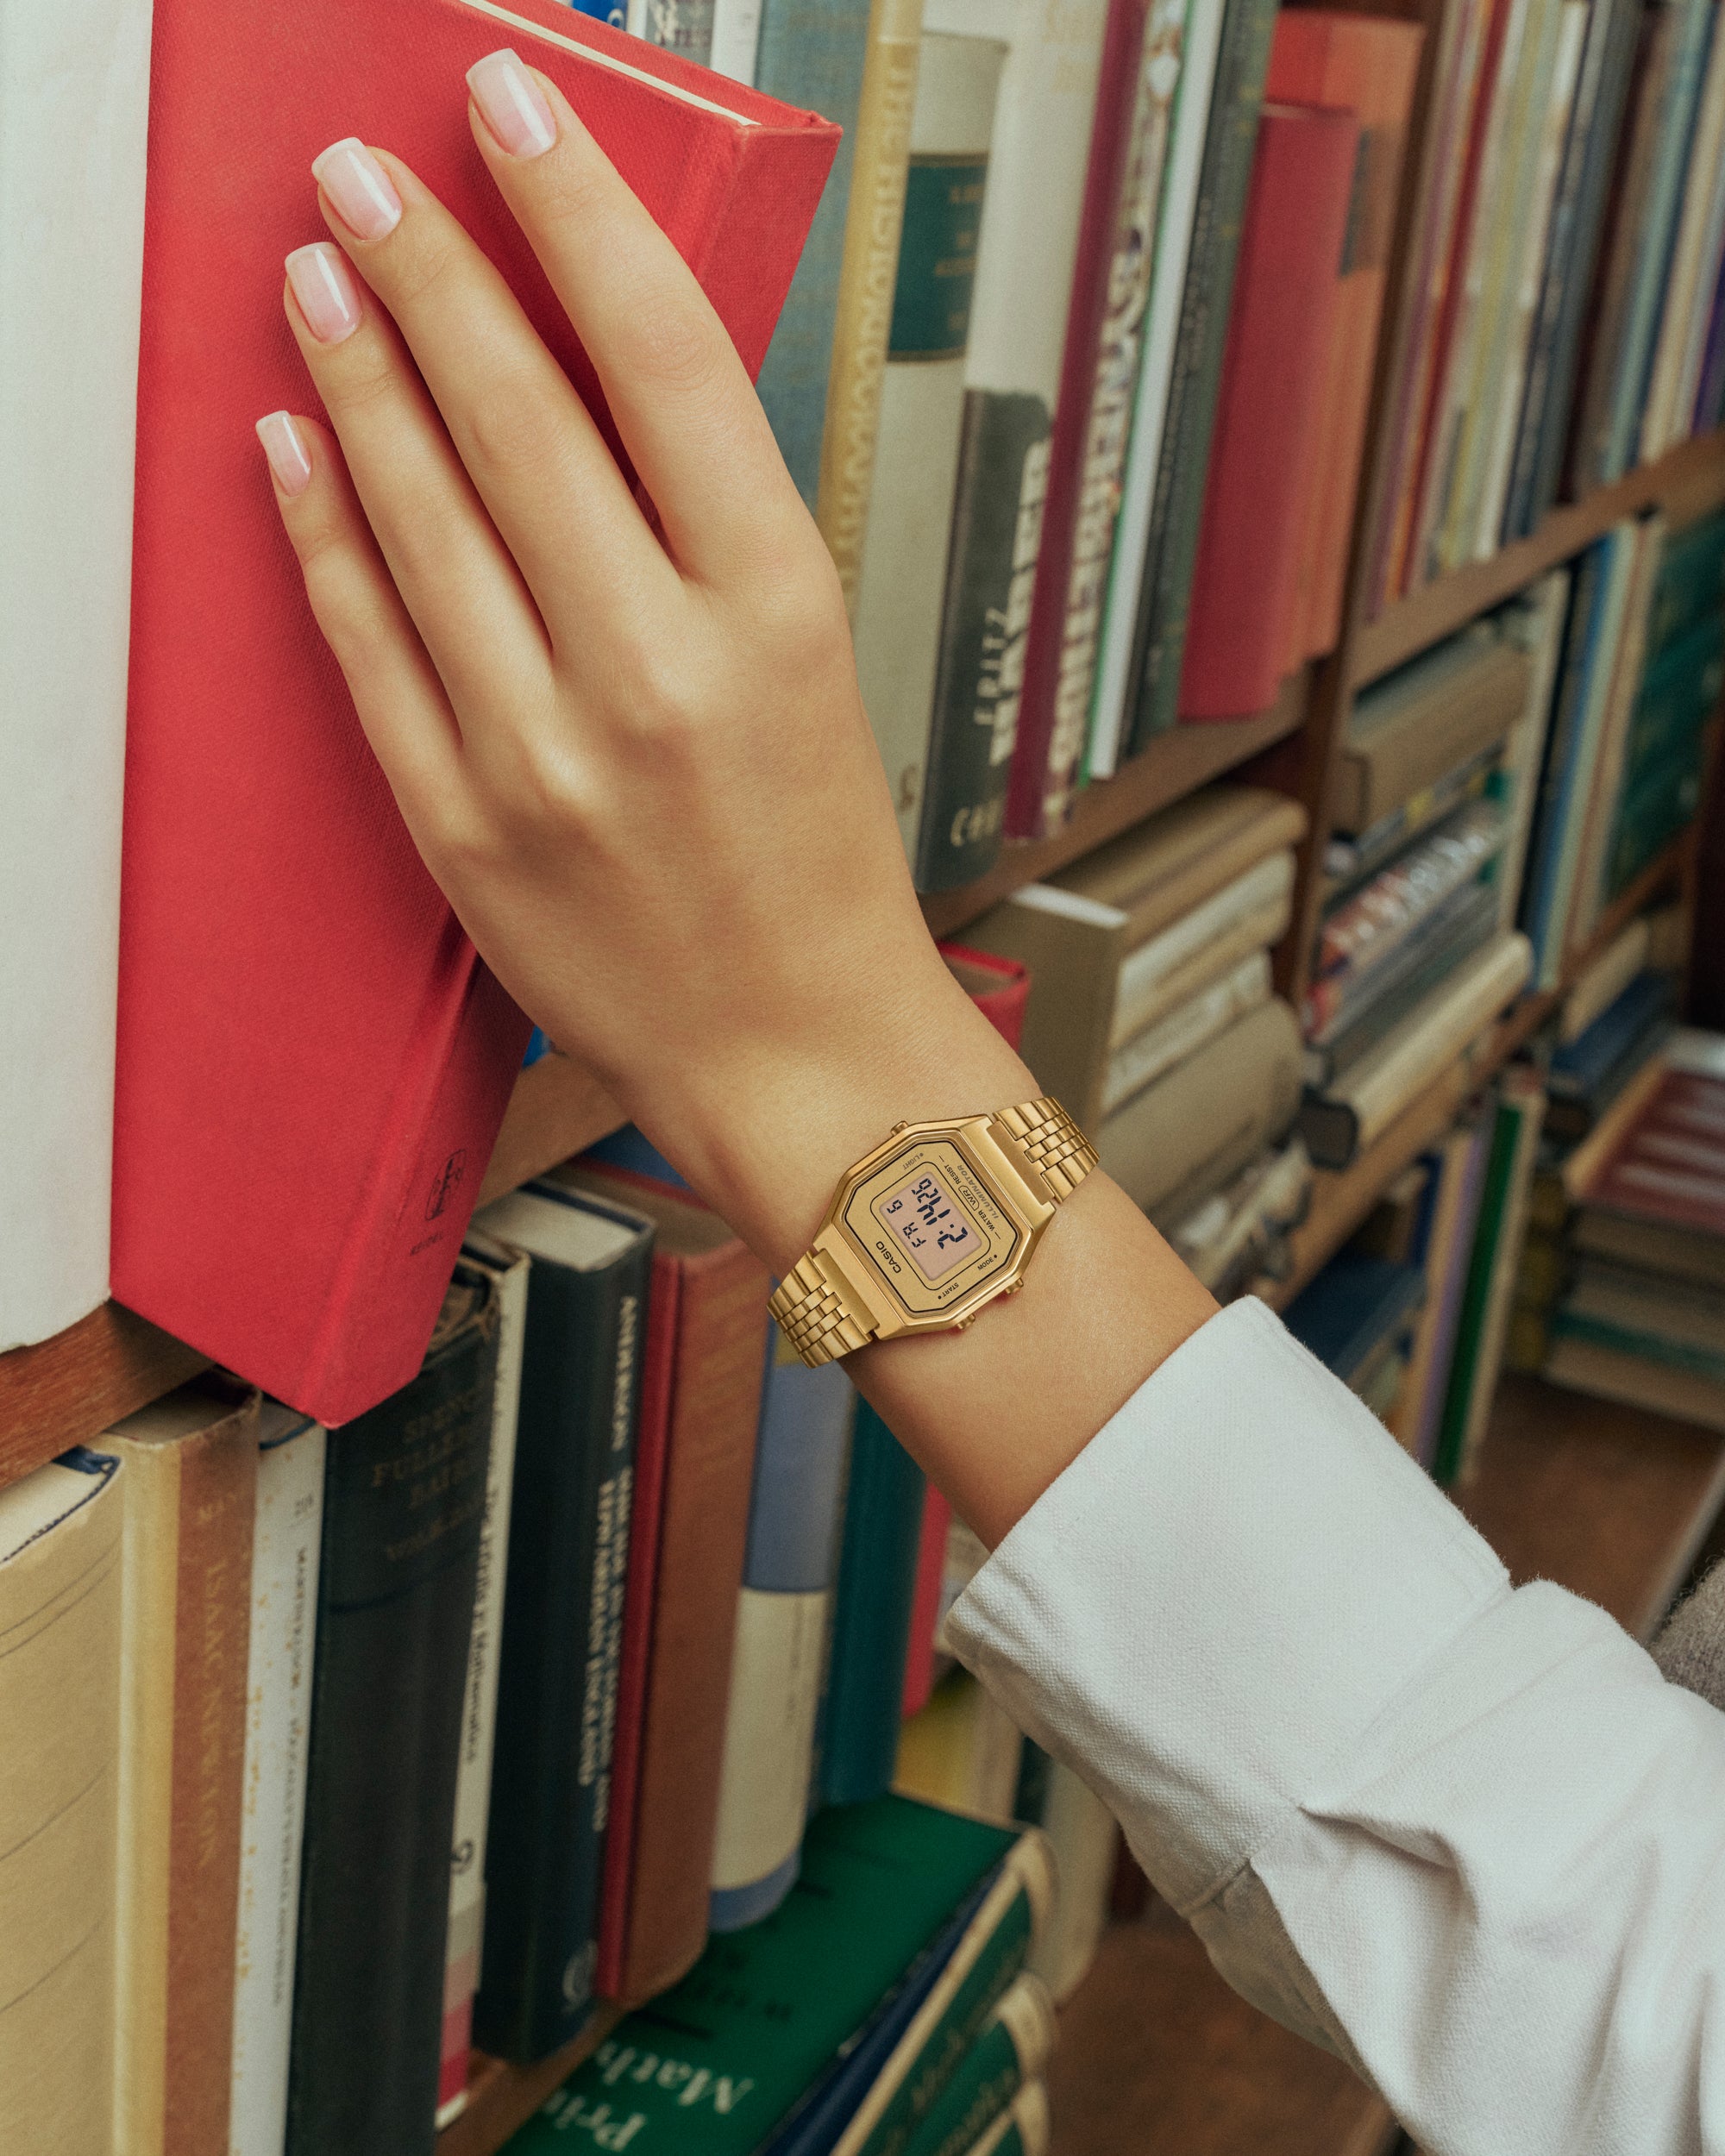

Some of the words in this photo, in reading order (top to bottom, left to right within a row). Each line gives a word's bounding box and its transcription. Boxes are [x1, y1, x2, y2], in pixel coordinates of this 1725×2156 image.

[902, 1154, 920, 1170] LIGHT
[944, 1164, 963, 1185] RESIST
[957, 1164, 1000, 1219] ILLUMINATOR
[961, 1188, 978, 1208] WR
[887, 1199, 903, 1214] 6
[978, 1209, 997, 1232] WATER
[875, 1240, 902, 1275] CASIO
[977, 1257, 994, 1271] MODE
[941, 1282, 960, 1298] START
